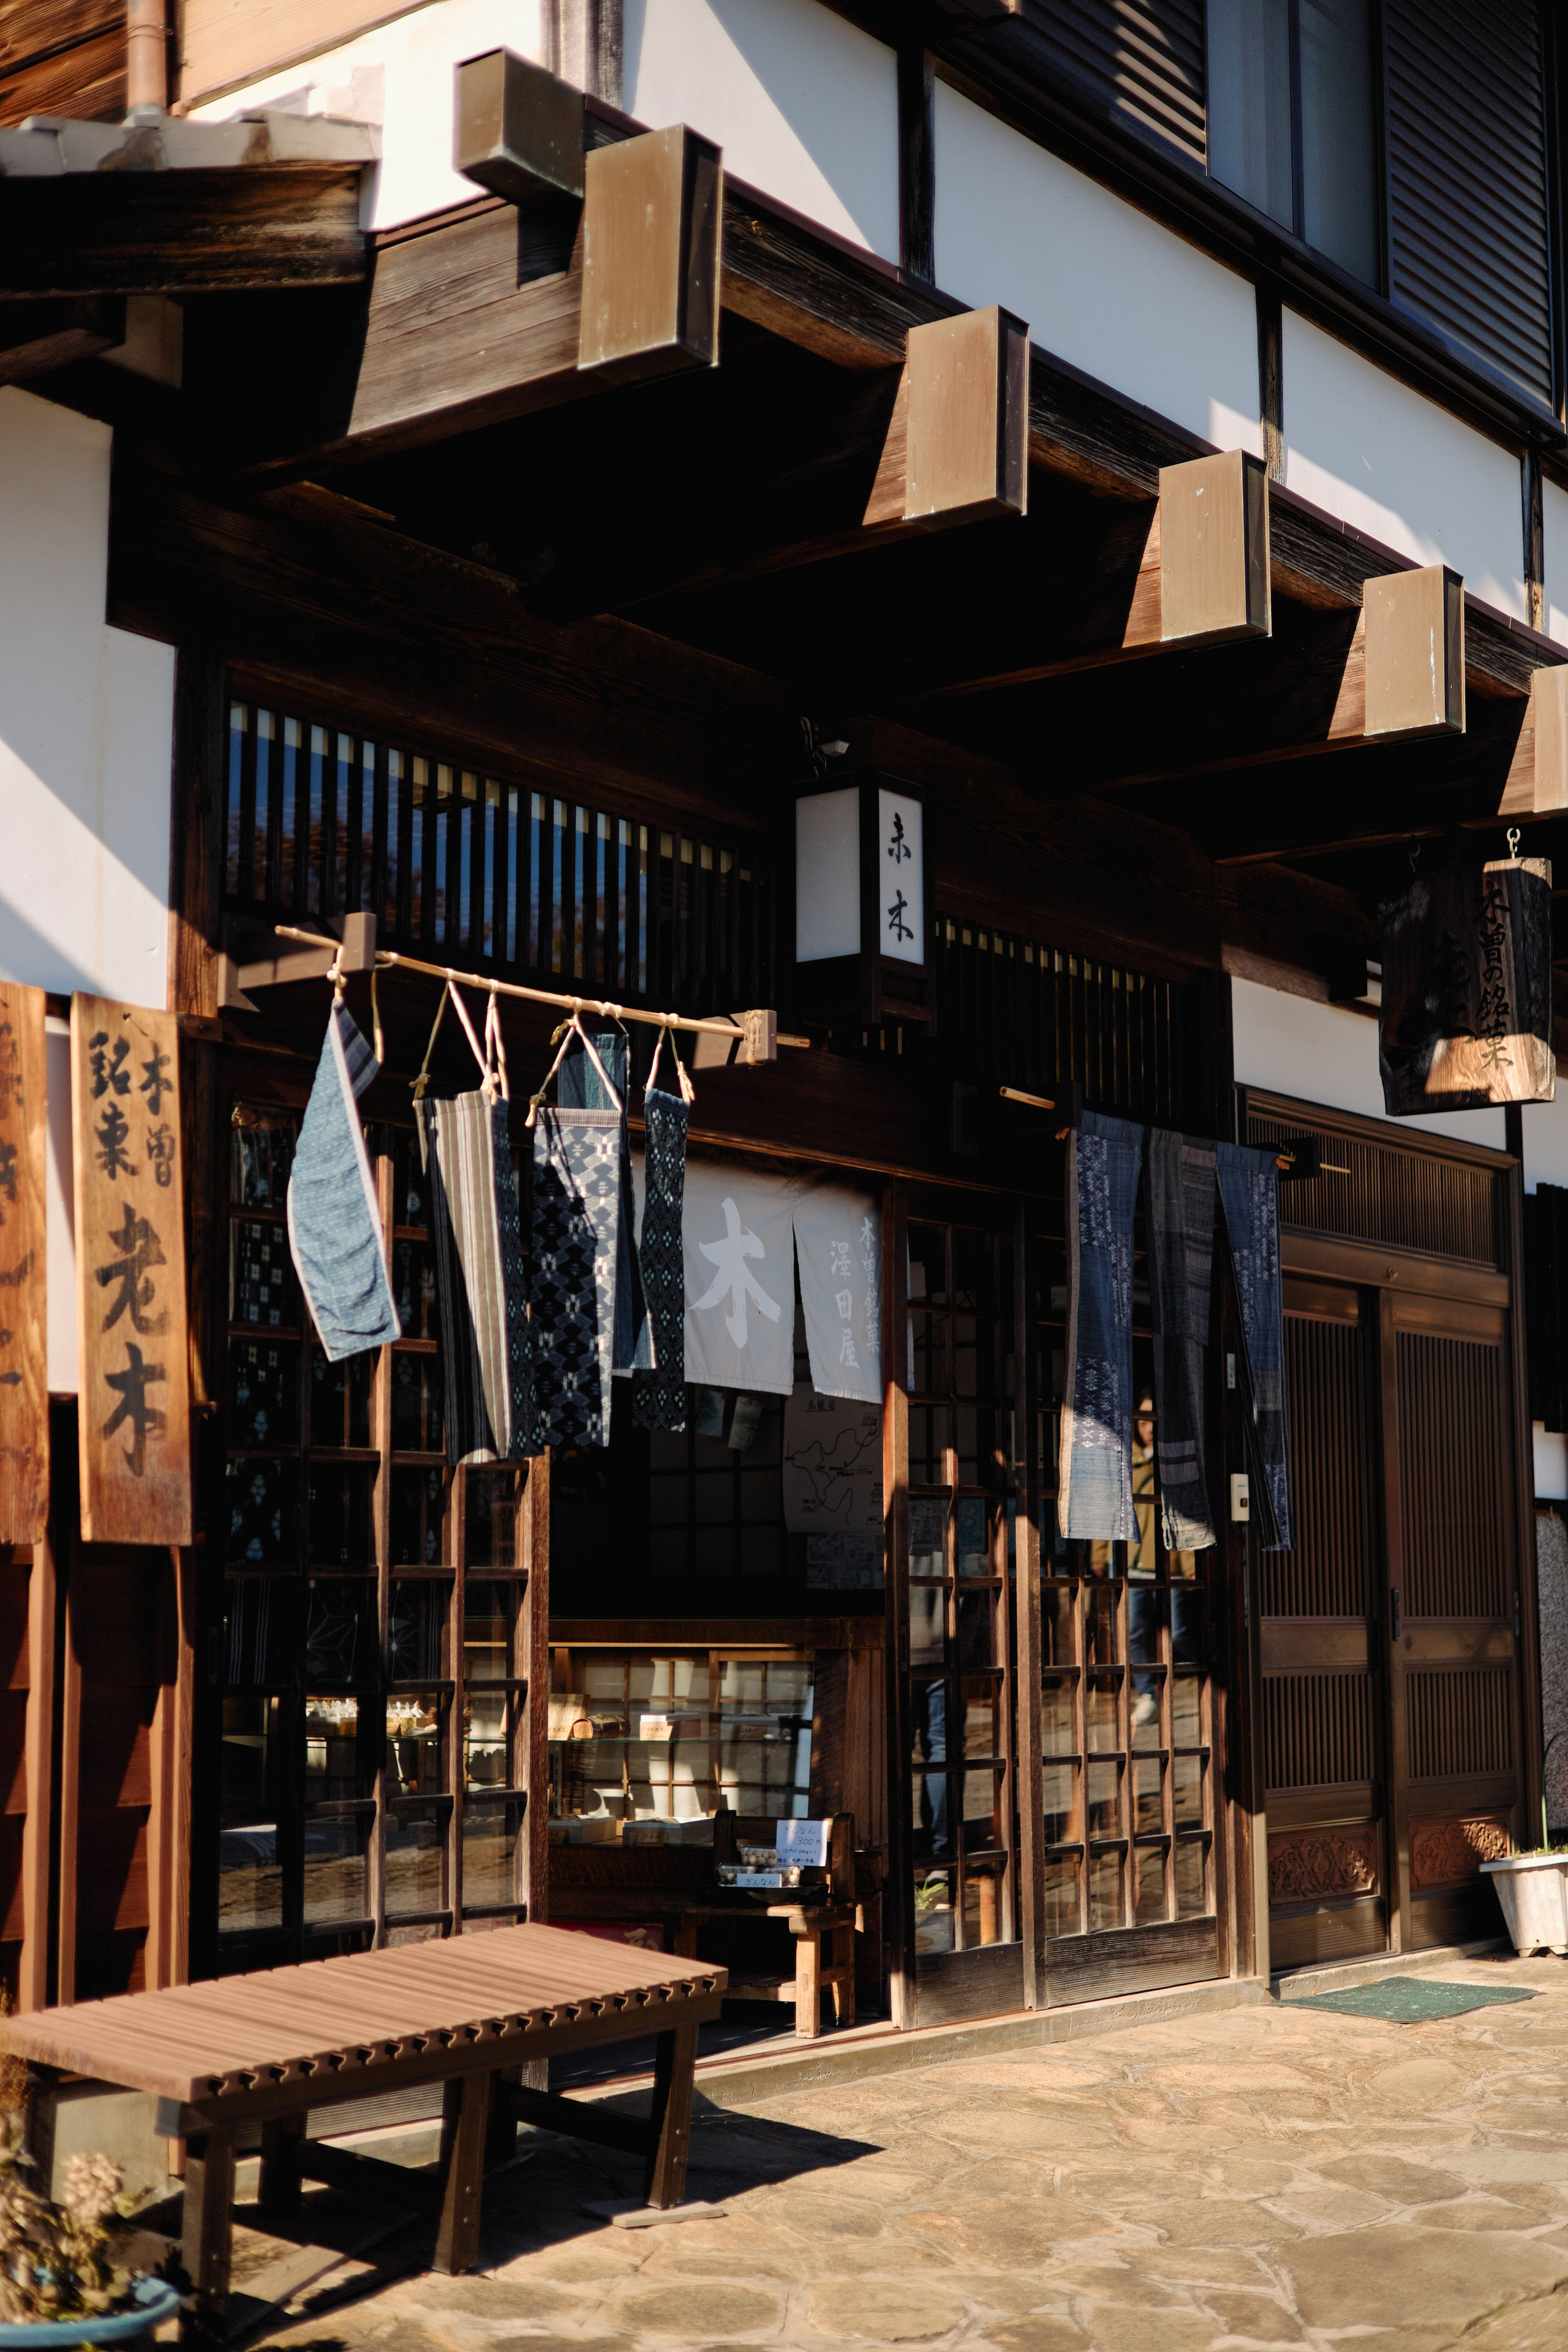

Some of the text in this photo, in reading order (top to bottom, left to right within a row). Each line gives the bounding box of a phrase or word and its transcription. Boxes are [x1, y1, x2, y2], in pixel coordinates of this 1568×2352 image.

[140, 1039, 176, 1187] 木曽
[95, 1201, 170, 1477] 老木
[687, 1196, 782, 1349] 木
[831, 1240, 860, 1369] 澤田屋
[859, 1216, 881, 1354] 木曽銘菓
[745, 1877, 776, 1886] ぎんなん
